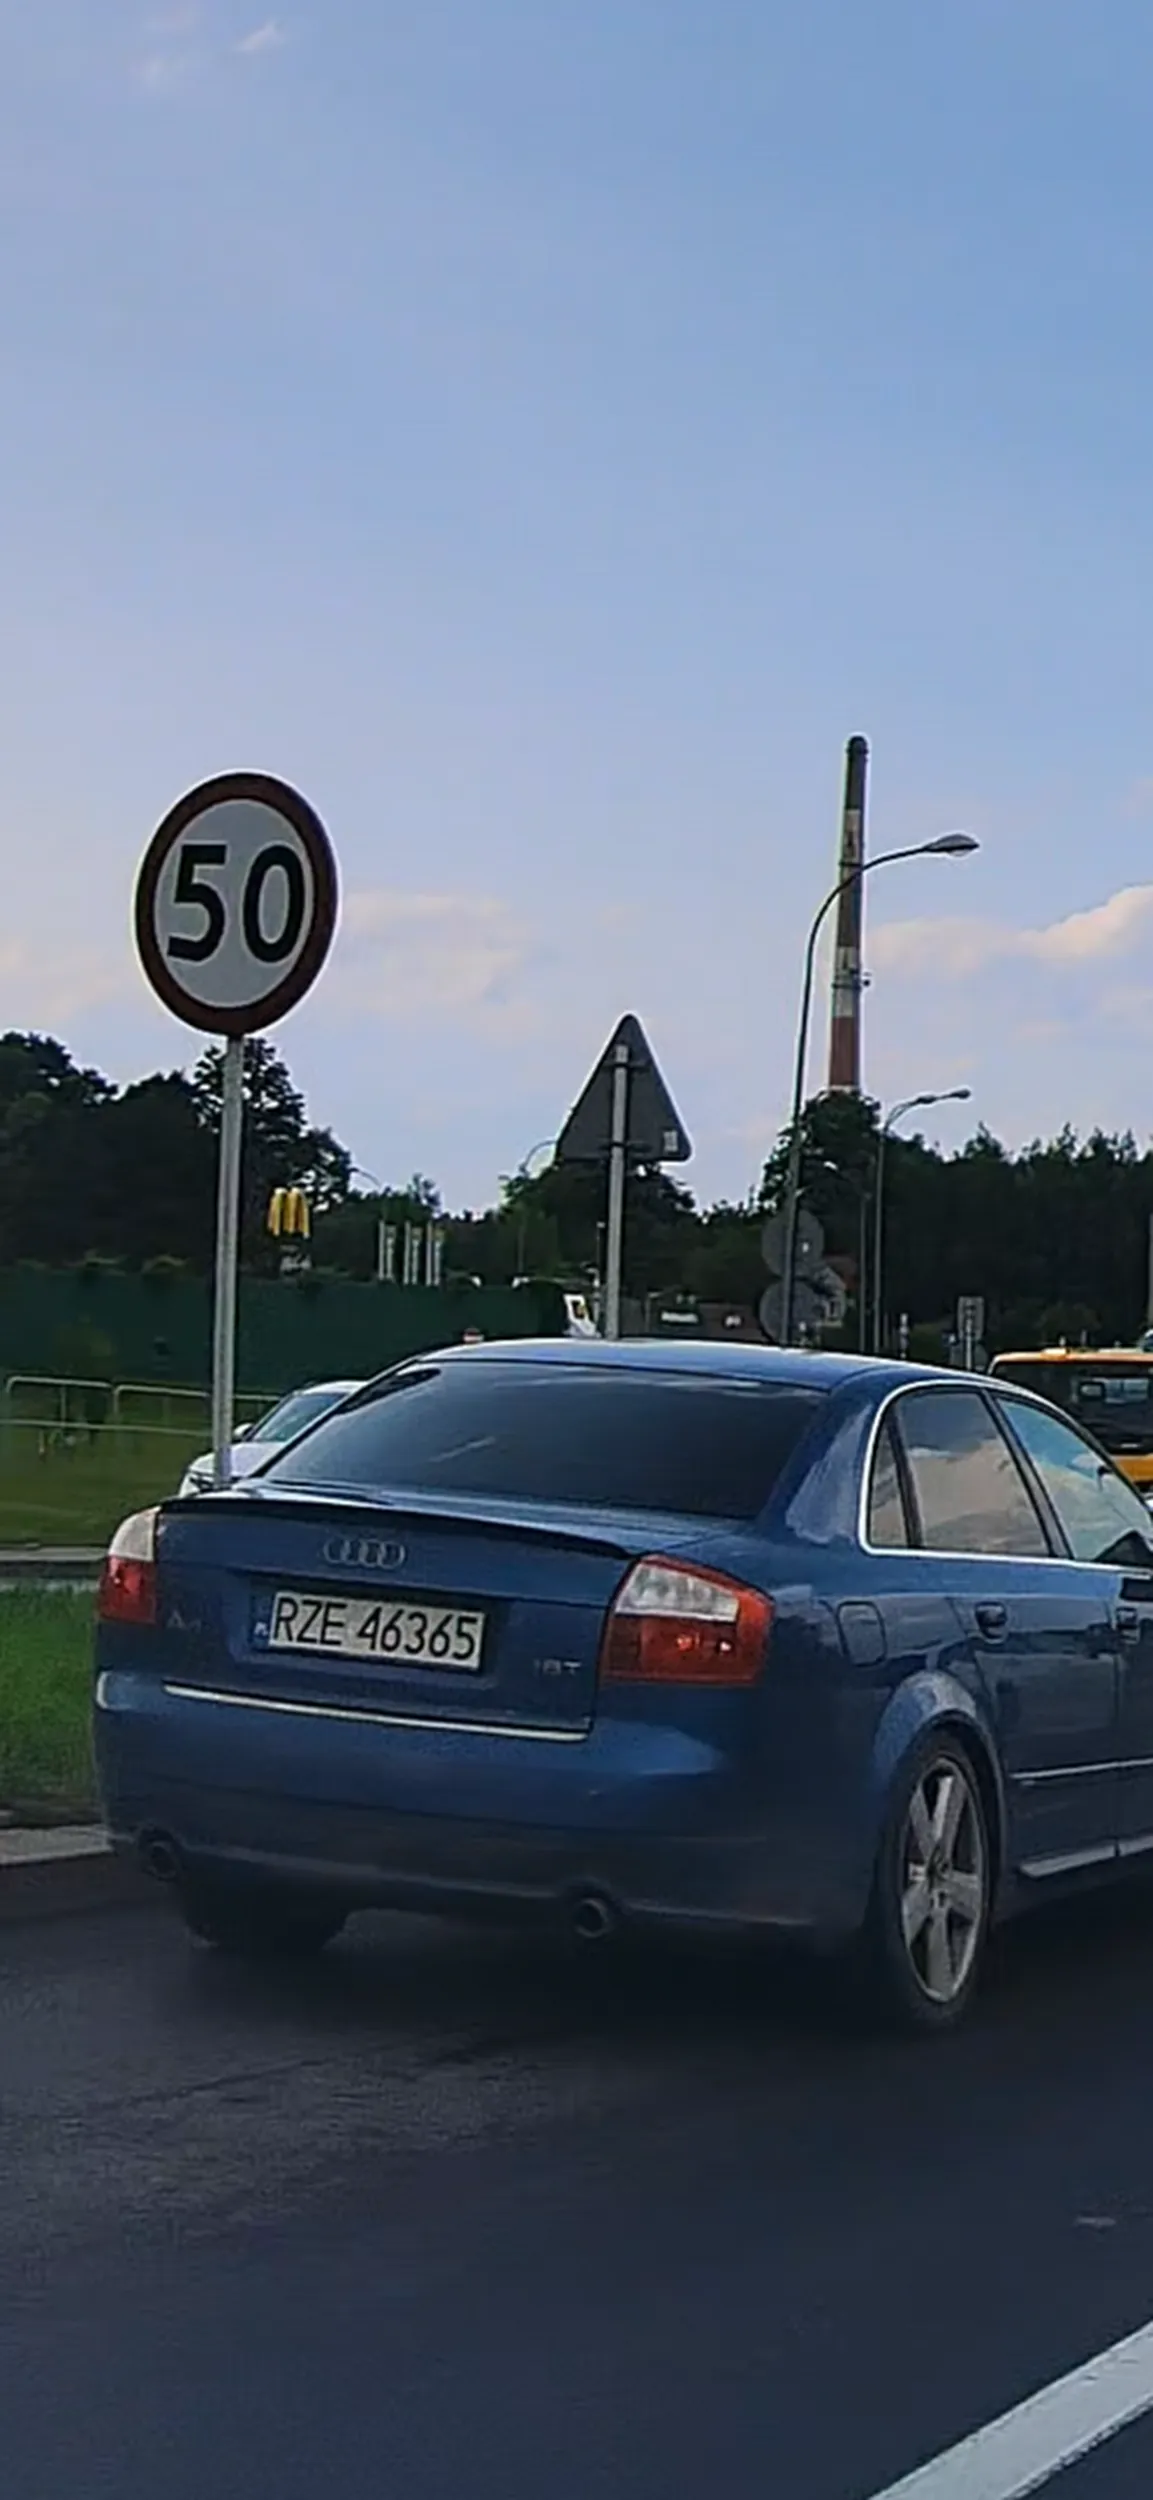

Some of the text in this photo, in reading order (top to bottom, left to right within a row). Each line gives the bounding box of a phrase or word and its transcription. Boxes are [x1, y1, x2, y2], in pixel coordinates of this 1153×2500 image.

[167, 844, 305, 963] 50
[273, 1597, 478, 1660] RZE 46365
